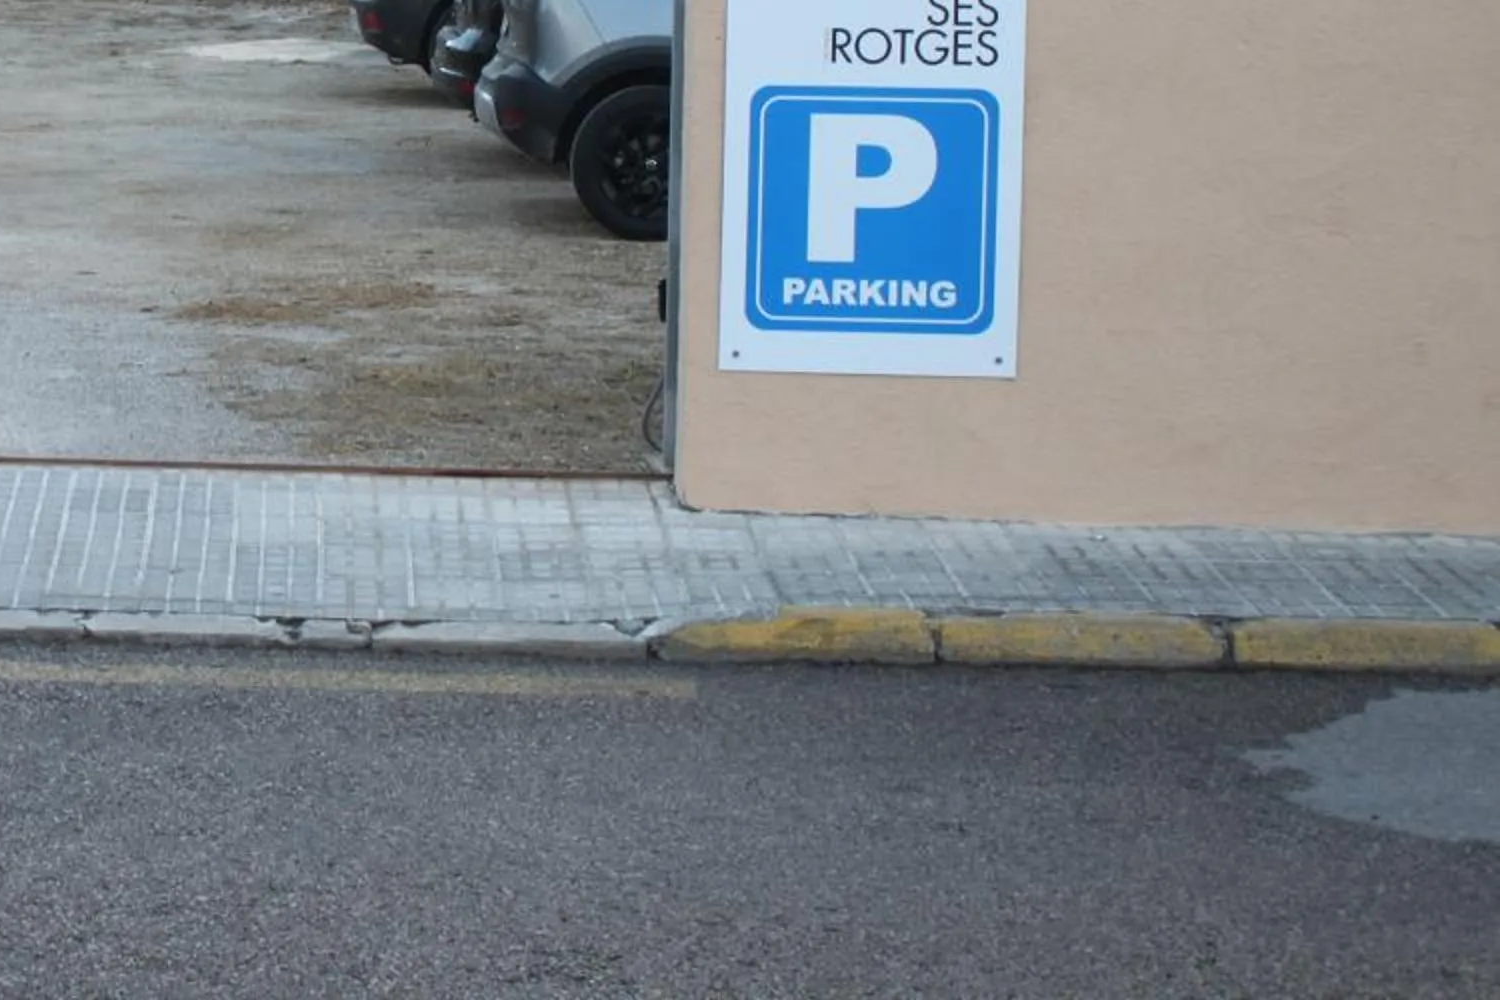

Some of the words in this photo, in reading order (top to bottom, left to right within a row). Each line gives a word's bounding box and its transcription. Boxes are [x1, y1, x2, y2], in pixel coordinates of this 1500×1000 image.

[831, 27, 999, 67] ROTGES
[806, 112, 938, 263] P
[783, 277, 957, 308] PARKING
